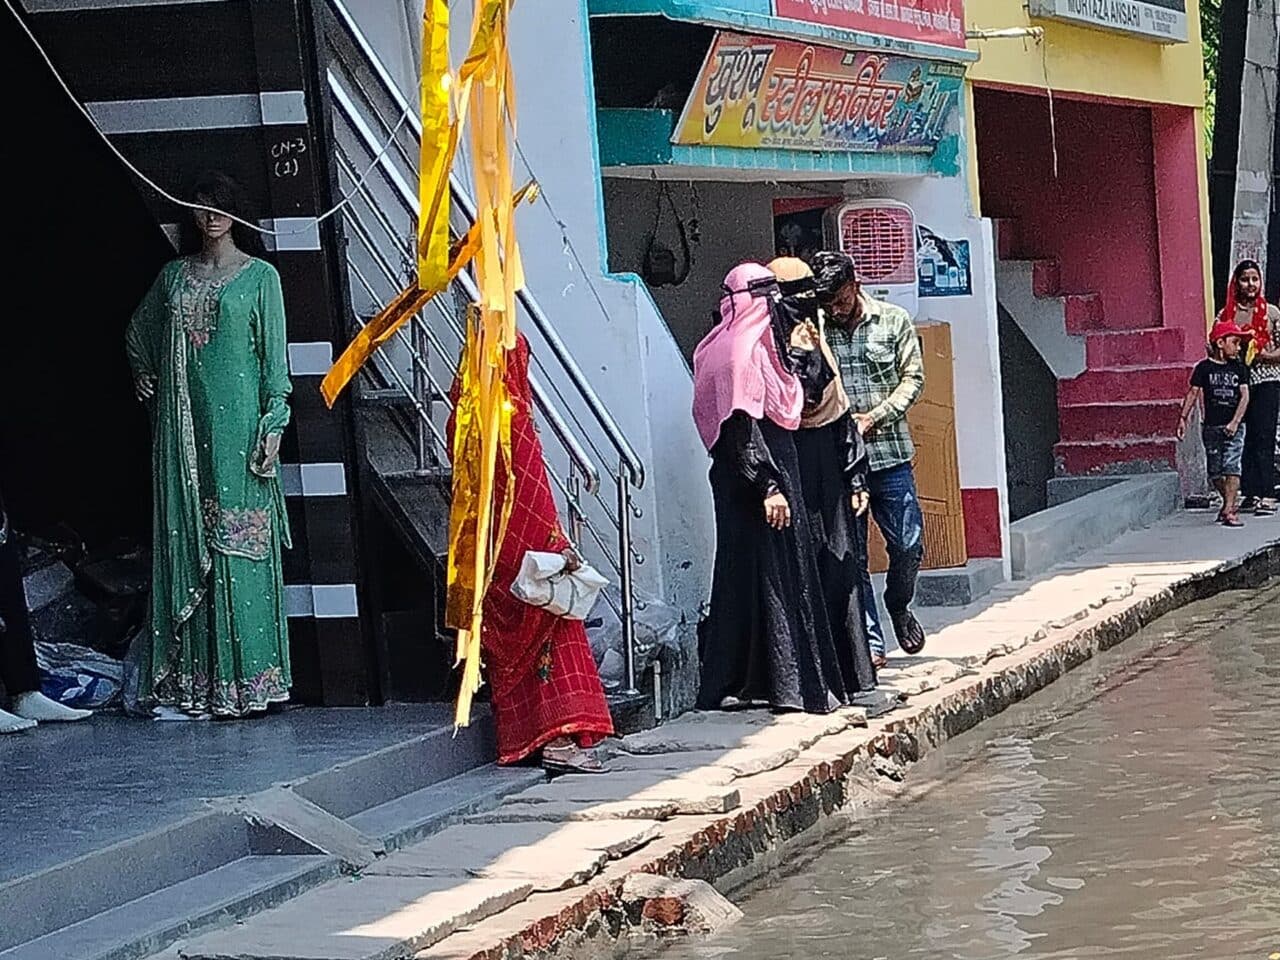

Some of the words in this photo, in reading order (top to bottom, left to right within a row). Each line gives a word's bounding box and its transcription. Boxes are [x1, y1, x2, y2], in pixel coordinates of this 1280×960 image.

[1110, 1, 1140, 28] ANSARI
[704, 45, 775, 136] खुशबू
[271, 137, 306, 158] CN-3
[274, 158, 299, 178] (1)
[1209, 373, 1239, 387] MUSIC
